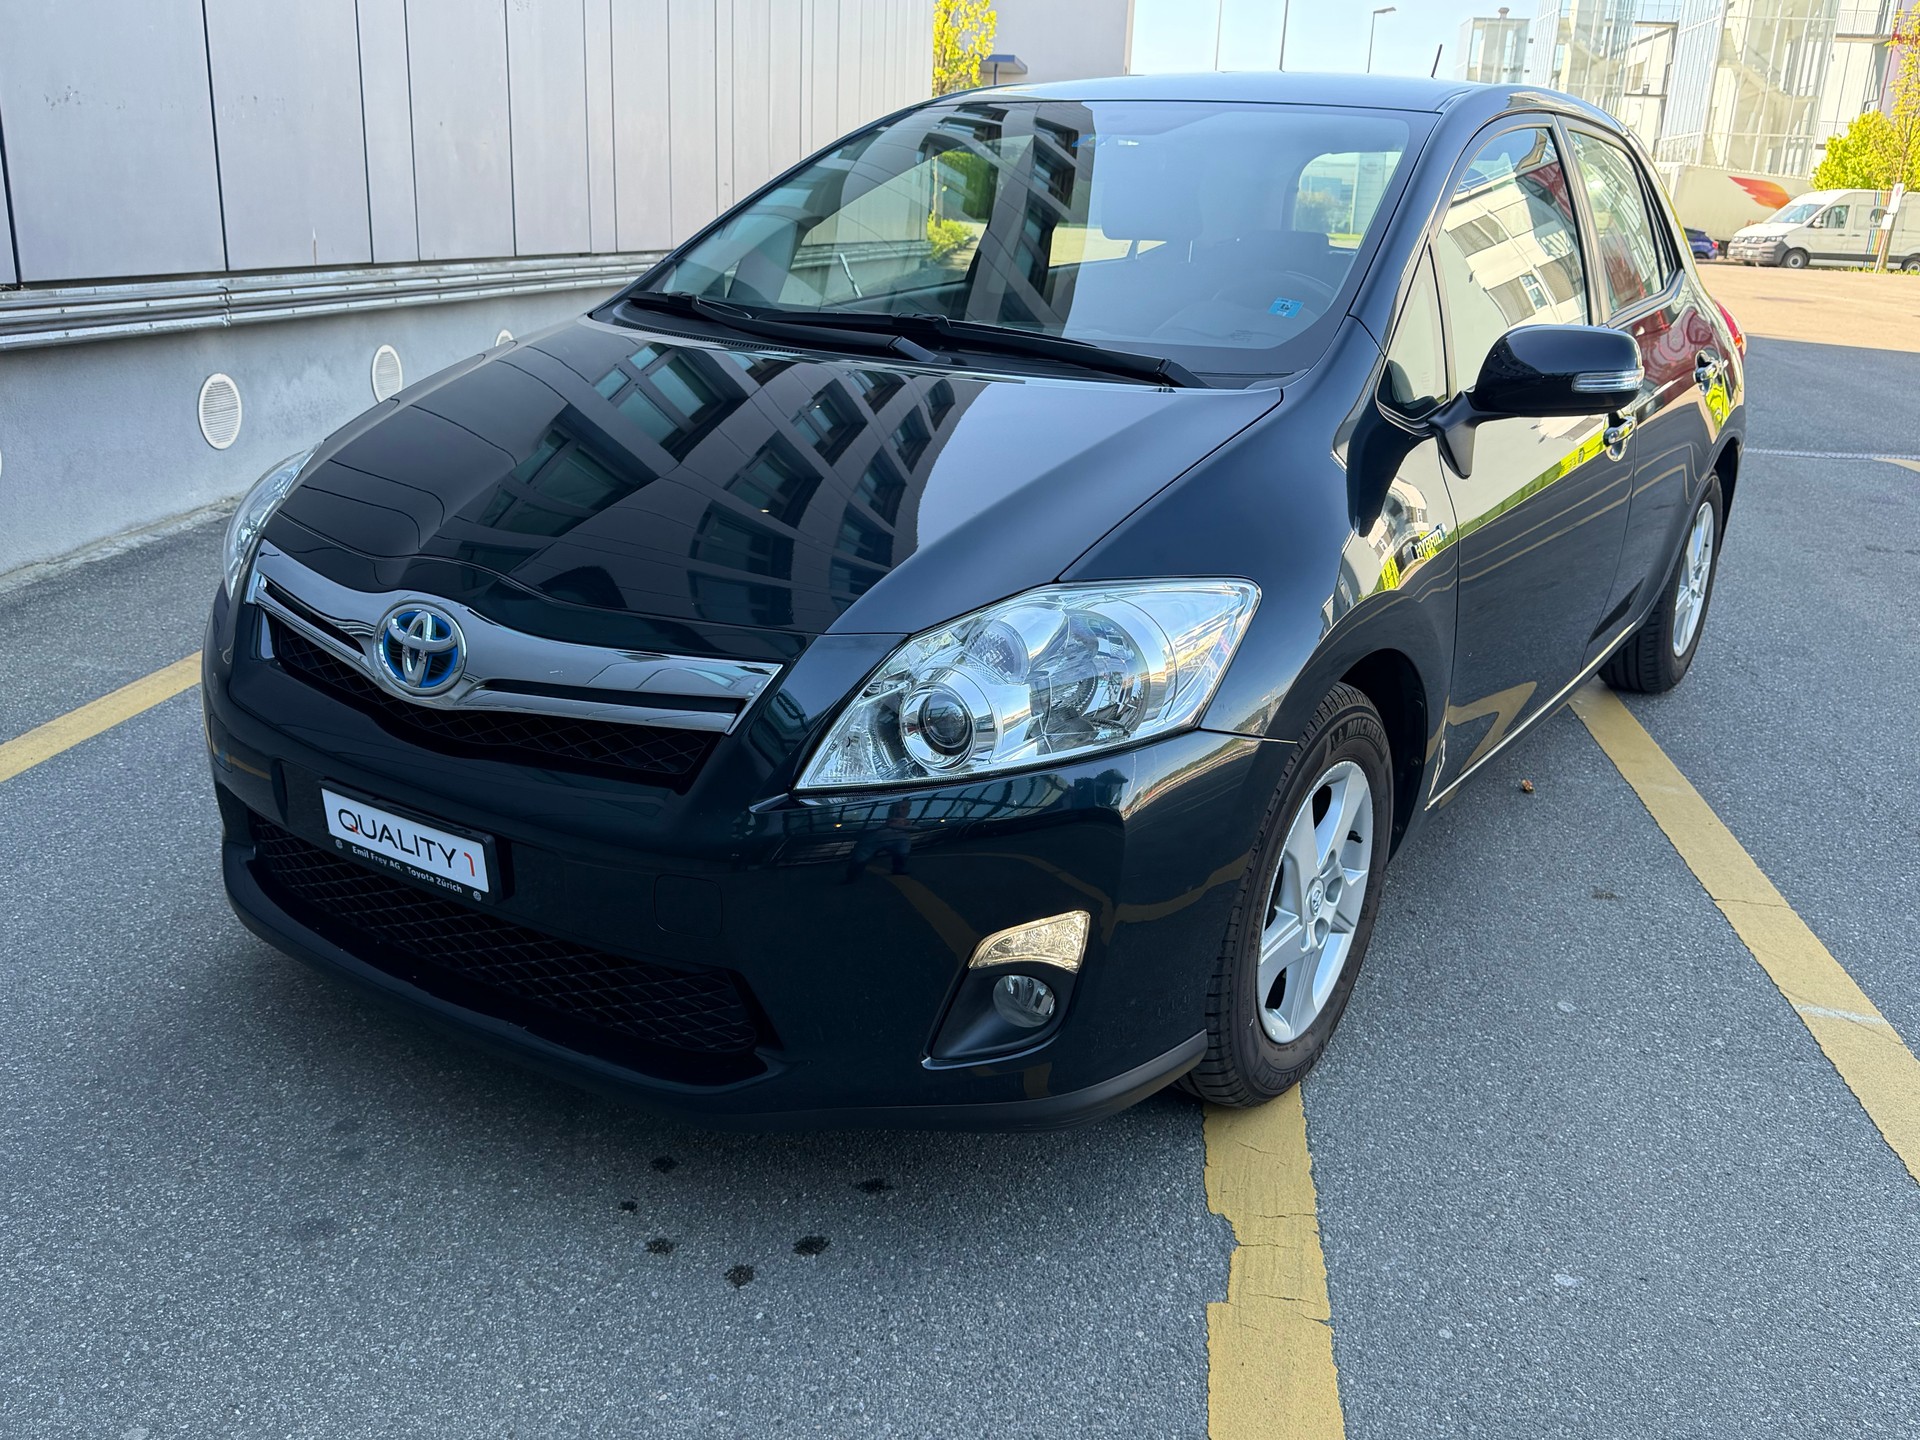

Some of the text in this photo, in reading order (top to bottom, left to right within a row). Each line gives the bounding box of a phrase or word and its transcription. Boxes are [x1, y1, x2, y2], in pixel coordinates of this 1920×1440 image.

[1414, 528, 1444, 559] HYBRID
[338, 808, 476, 877] QUALITY 1
[352, 845, 369, 859] Emil
[370, 851, 387, 867] Frey
[406, 866, 434, 884] Toyota
[436, 876, 463, 894] Zürich
